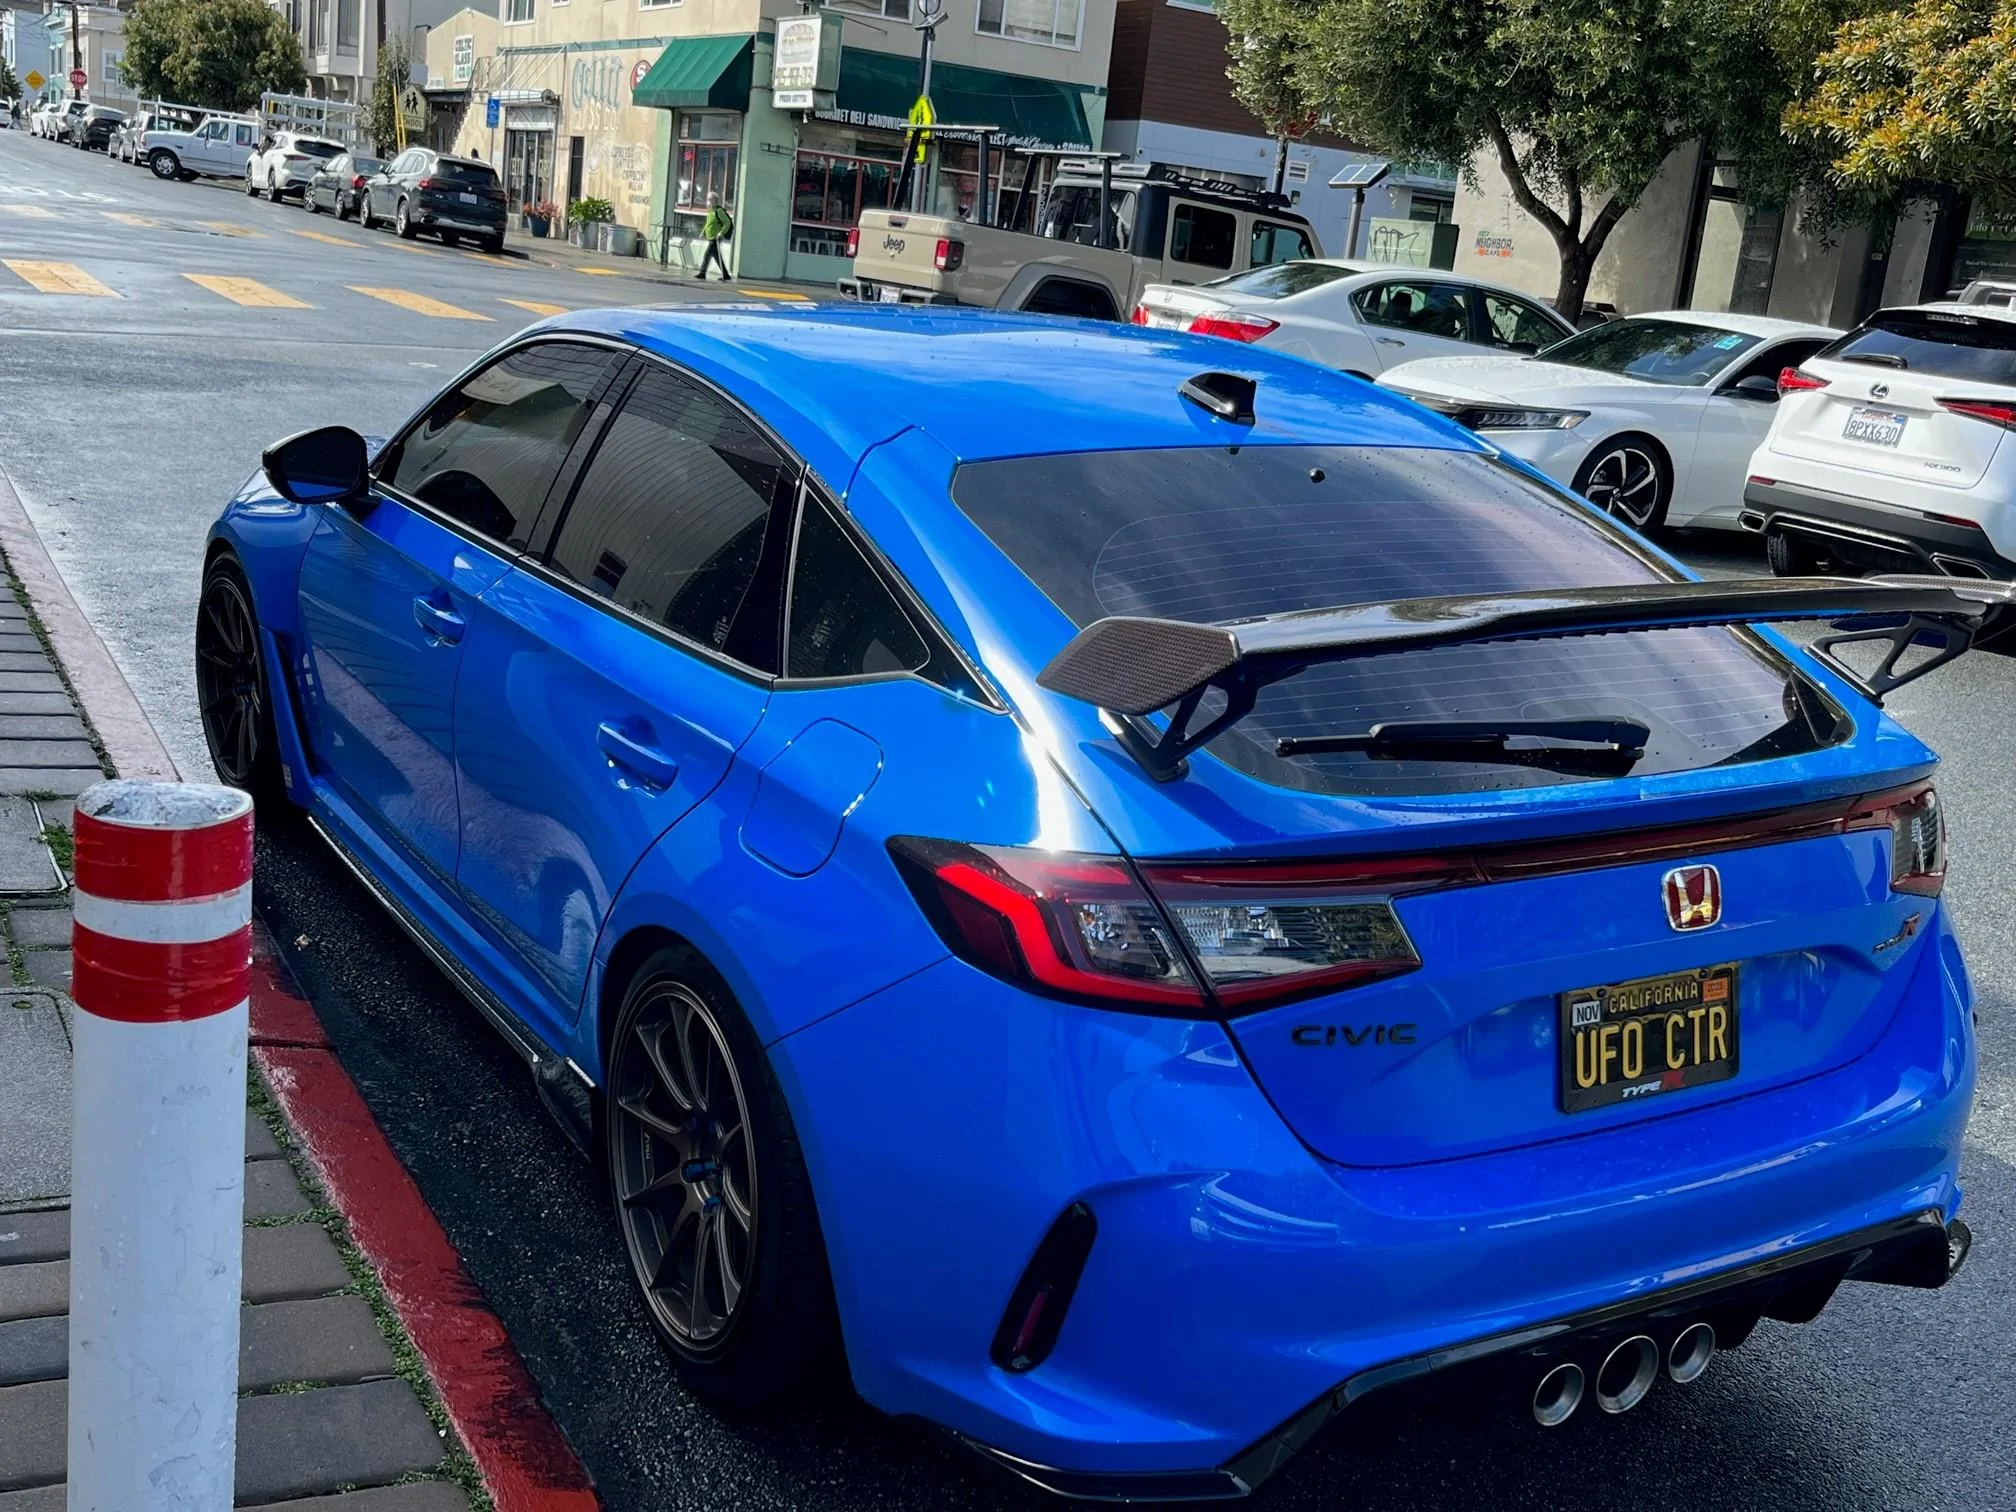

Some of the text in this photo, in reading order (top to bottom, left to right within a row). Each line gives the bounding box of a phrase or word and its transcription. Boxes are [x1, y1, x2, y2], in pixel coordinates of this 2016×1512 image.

[71, 74, 87, 83] STOP
[850, 110, 866, 125] DELI
[867, 113, 909, 130] SANDWIC
[883, 234, 906, 254] Jeep
[1848, 419, 1898, 441] 8PXX630
[1609, 982, 1699, 1014] CALIFORNIA
[1576, 1004, 1600, 1024] NOV
[1292, 1024, 1417, 1046] CIVIC
[1575, 1005, 1728, 1089] UFO CTR
[1621, 1080, 1662, 1098] TYPE
